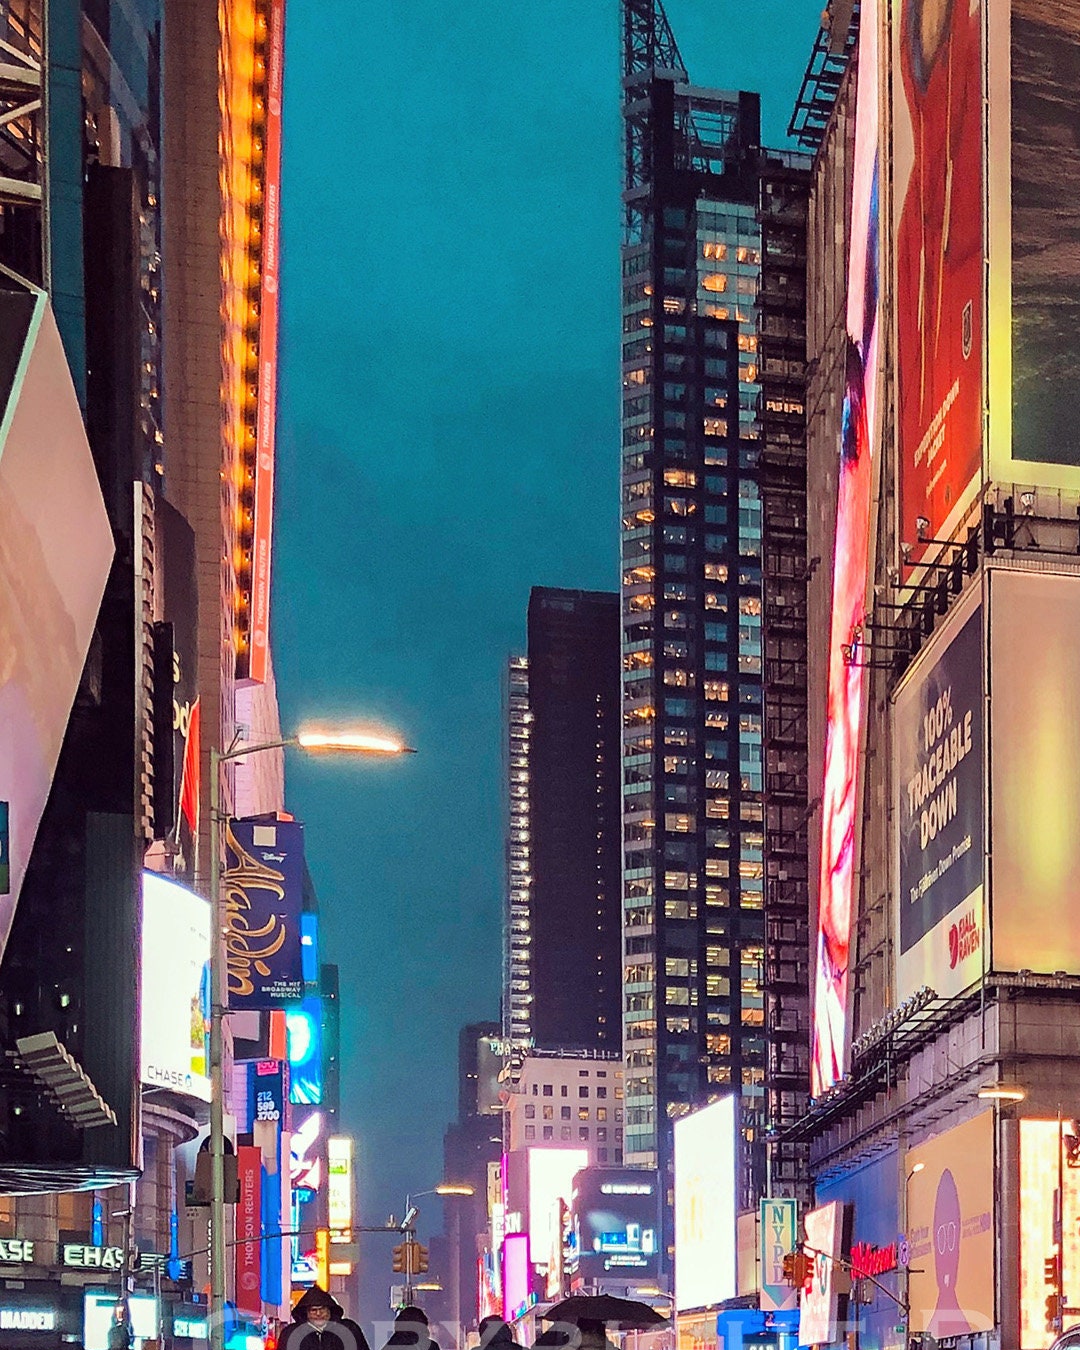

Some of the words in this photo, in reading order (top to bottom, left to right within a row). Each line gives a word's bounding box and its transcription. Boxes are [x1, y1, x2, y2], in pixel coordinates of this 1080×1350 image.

[268, 184, 276, 225] REUTERS
[267, 226, 275, 271] THOMSON
[257, 580, 266, 625] THOMSON
[924, 685, 953, 751] 100%
[908, 709, 973, 817] TRACEABLE
[921, 776, 957, 850] DOWN
[147, 1065, 183, 1087] CHASE
[257, 1091, 272, 1101] 212
[257, 1101, 275, 1111] 599
[245, 1169, 254, 1214] REUTERS
[245, 1216, 254, 1266] THOMSON
[772, 1205, 785, 1284] NYPD
